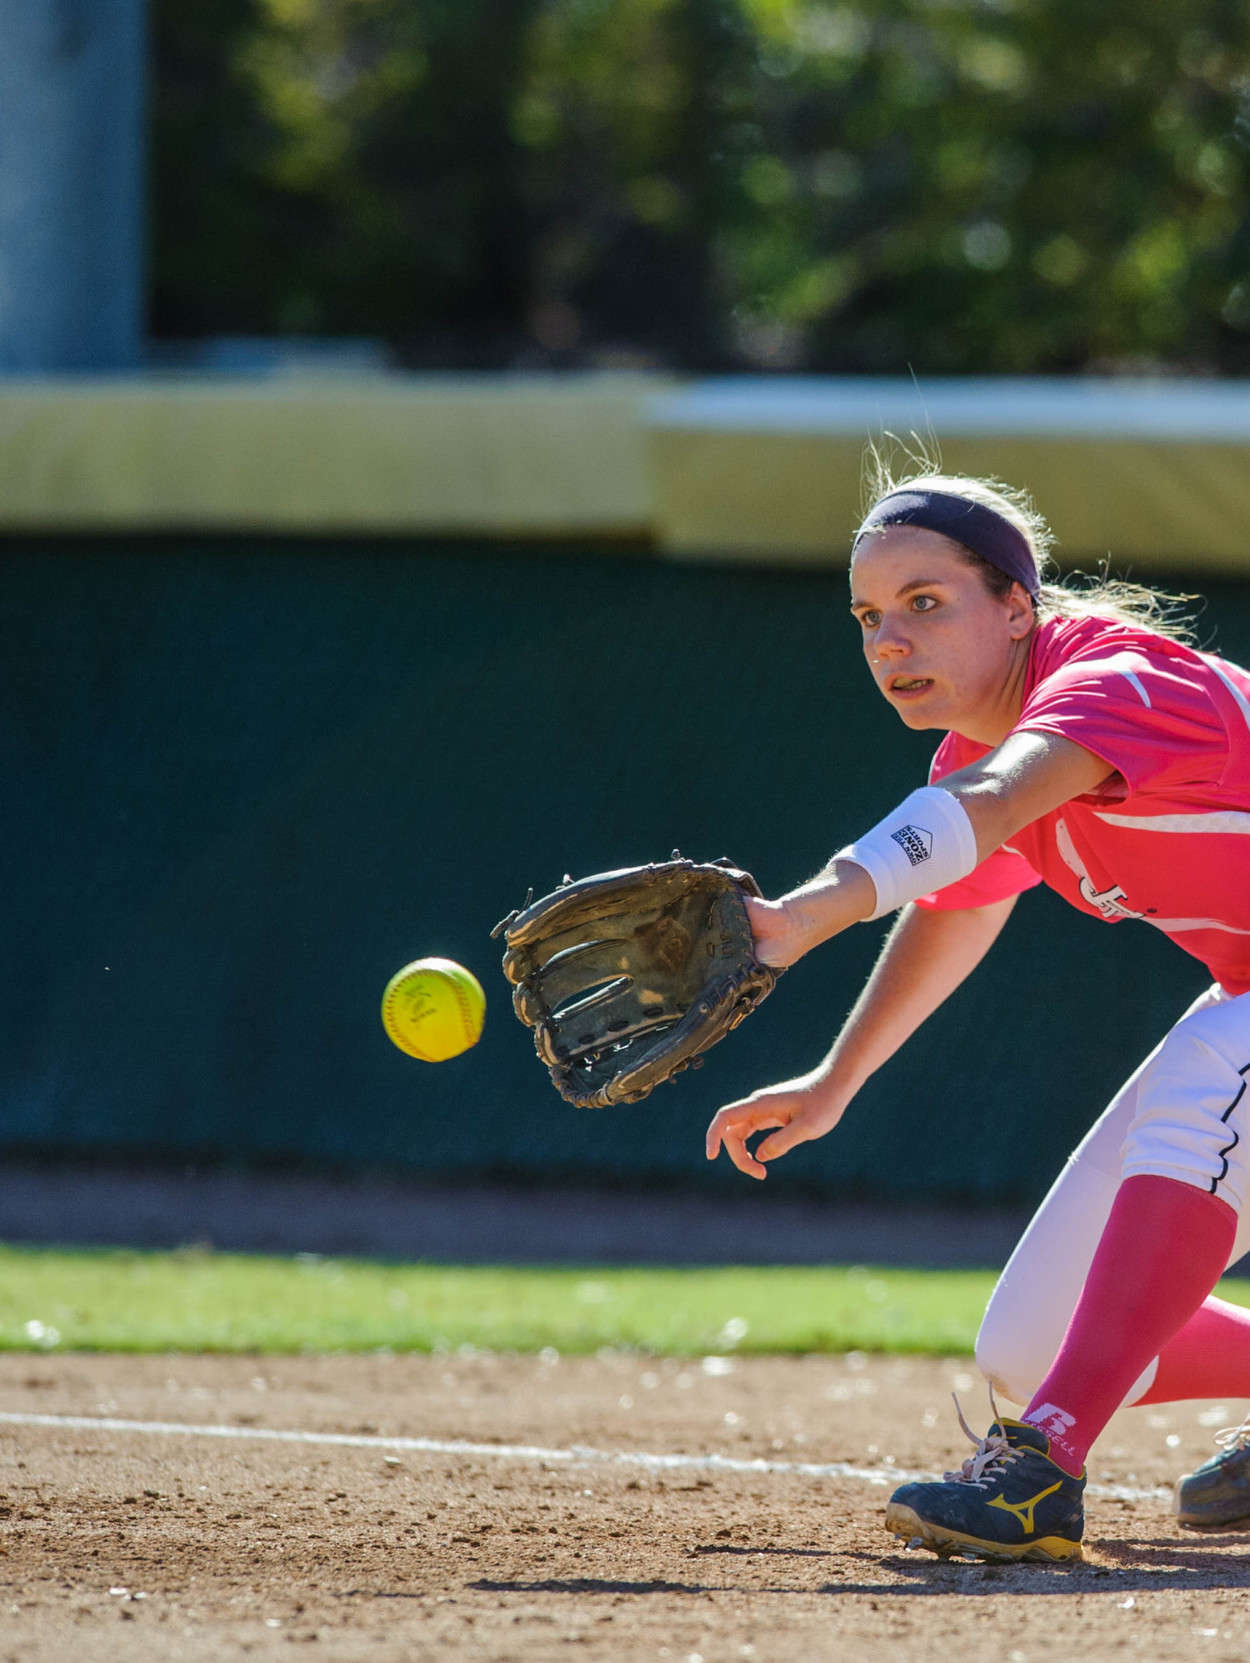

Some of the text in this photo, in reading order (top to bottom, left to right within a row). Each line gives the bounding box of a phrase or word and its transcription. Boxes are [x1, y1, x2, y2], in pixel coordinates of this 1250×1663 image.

[892, 831, 917, 864] OWN THE
[898, 828, 924, 861] ZONE
[906, 825, 929, 857] SPORTS
